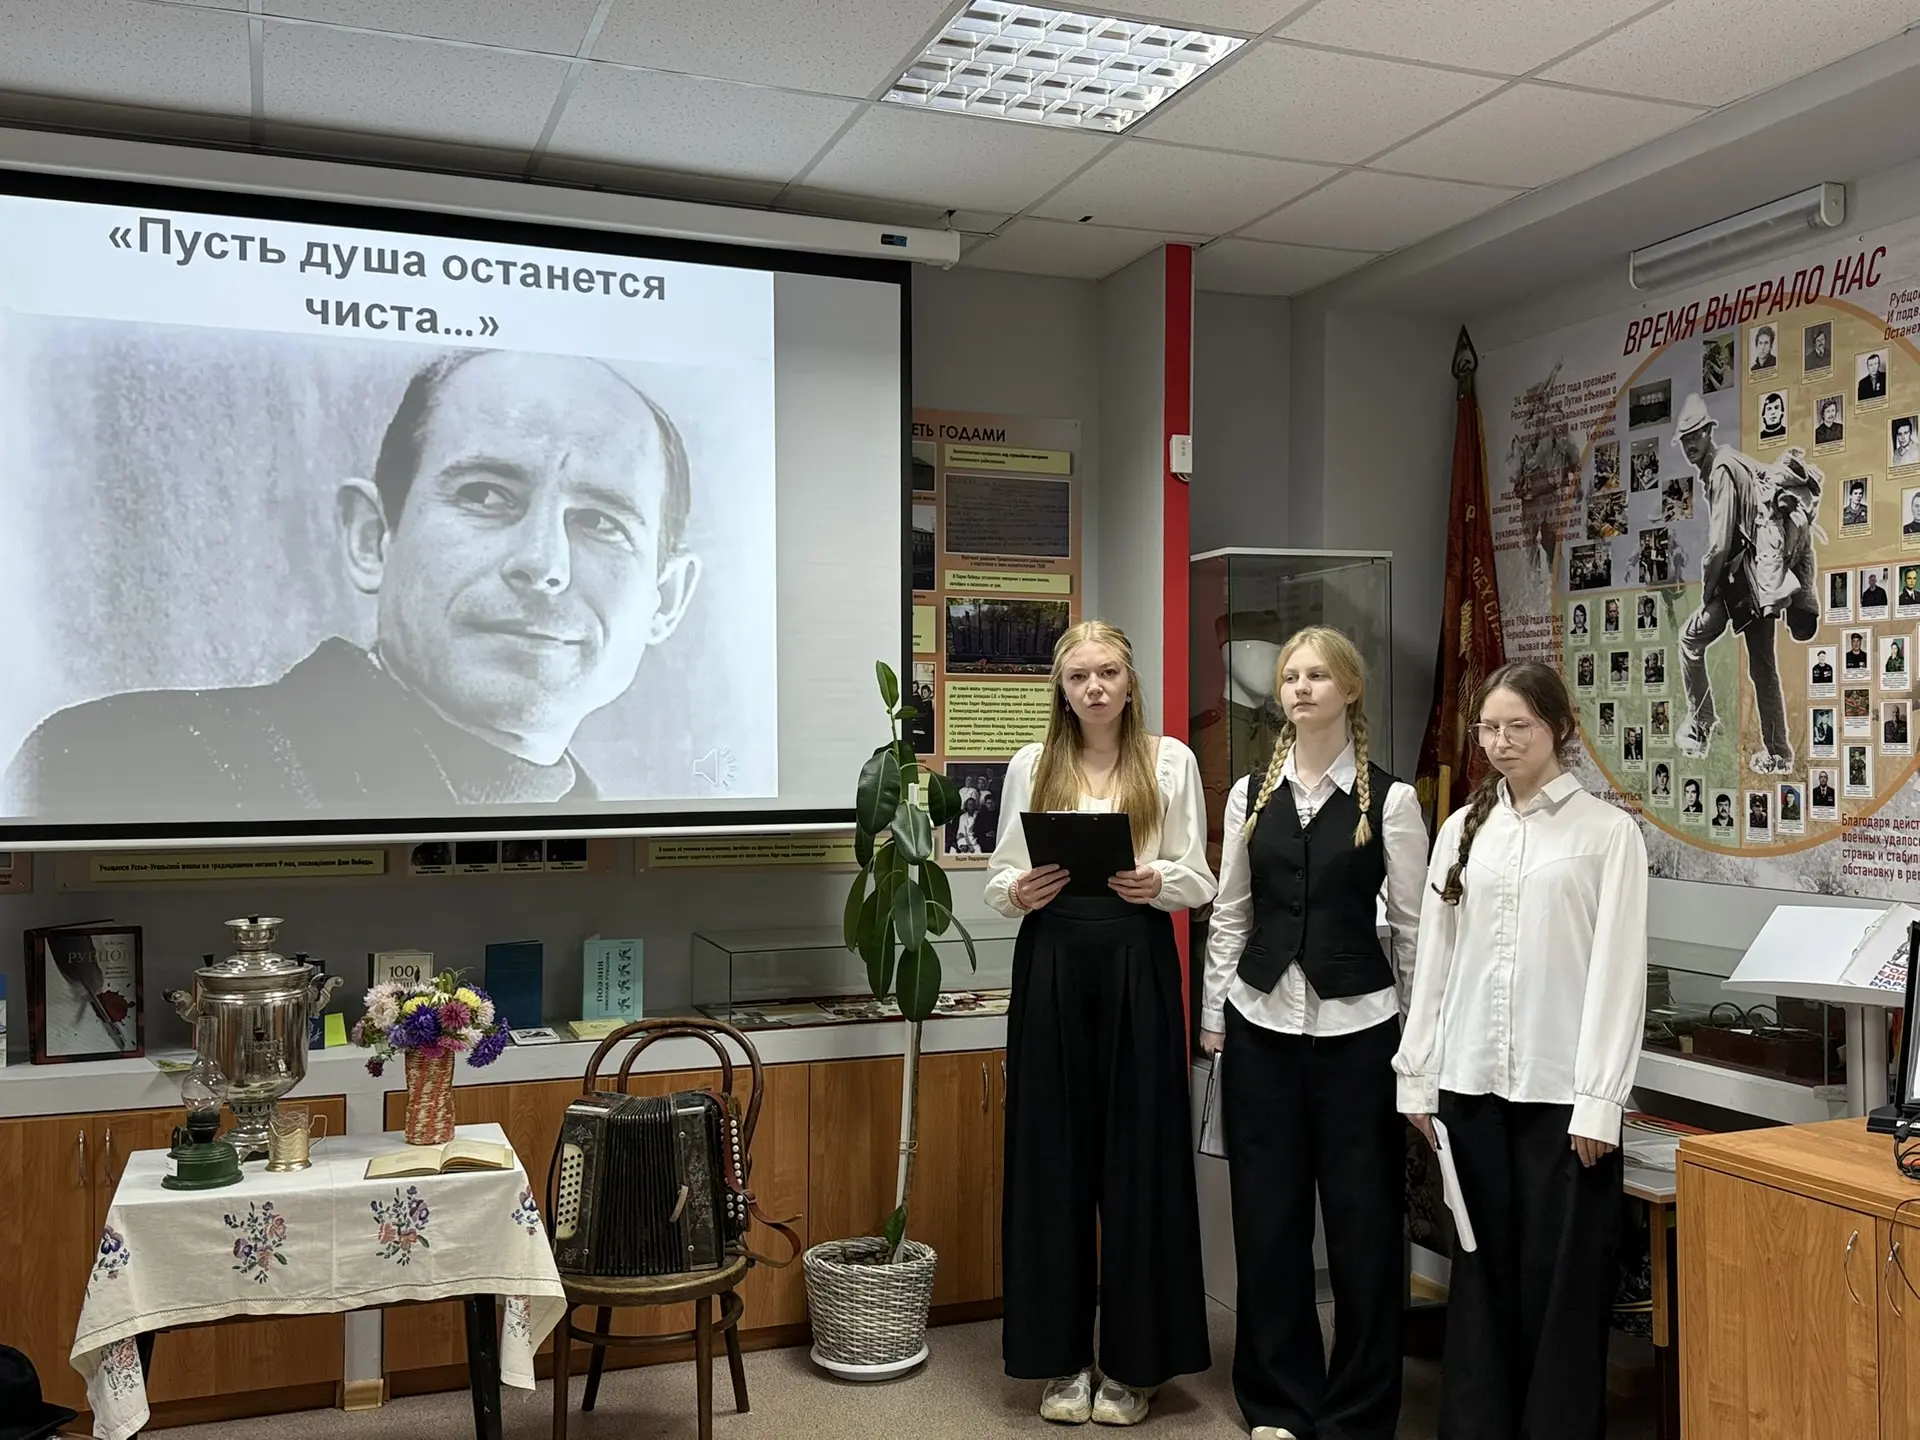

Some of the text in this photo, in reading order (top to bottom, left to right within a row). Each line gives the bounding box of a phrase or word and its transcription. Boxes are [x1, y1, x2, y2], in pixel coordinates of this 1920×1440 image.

[109, 216, 666, 300] «Пусть душа останется
[1622, 245, 1887, 357] ВРЕМЯ ВЫБРАЛО НАС
[1889, 289, 1920, 309] Рубцо
[305, 298, 499, 337] чиста...»
[1886, 306, 1920, 324] И подв
[1583, 372, 1617, 390] президент
[1584, 387, 1611, 402] объявил
[939, 425, 1007, 442] ГОДАМИ
[1841, 813, 1890, 831] Благодаря
[1842, 832, 1881, 845] военных
[1842, 849, 1920, 865] страны и стабил
[1842, 863, 1894, 881] обстановку
[1897, 870, 1903, 879] в
[390, 965, 414, 978] 100
[1877, 970, 1908, 983] ЕДИ
[596, 960, 604, 1003] ПОЭЗИЯ
